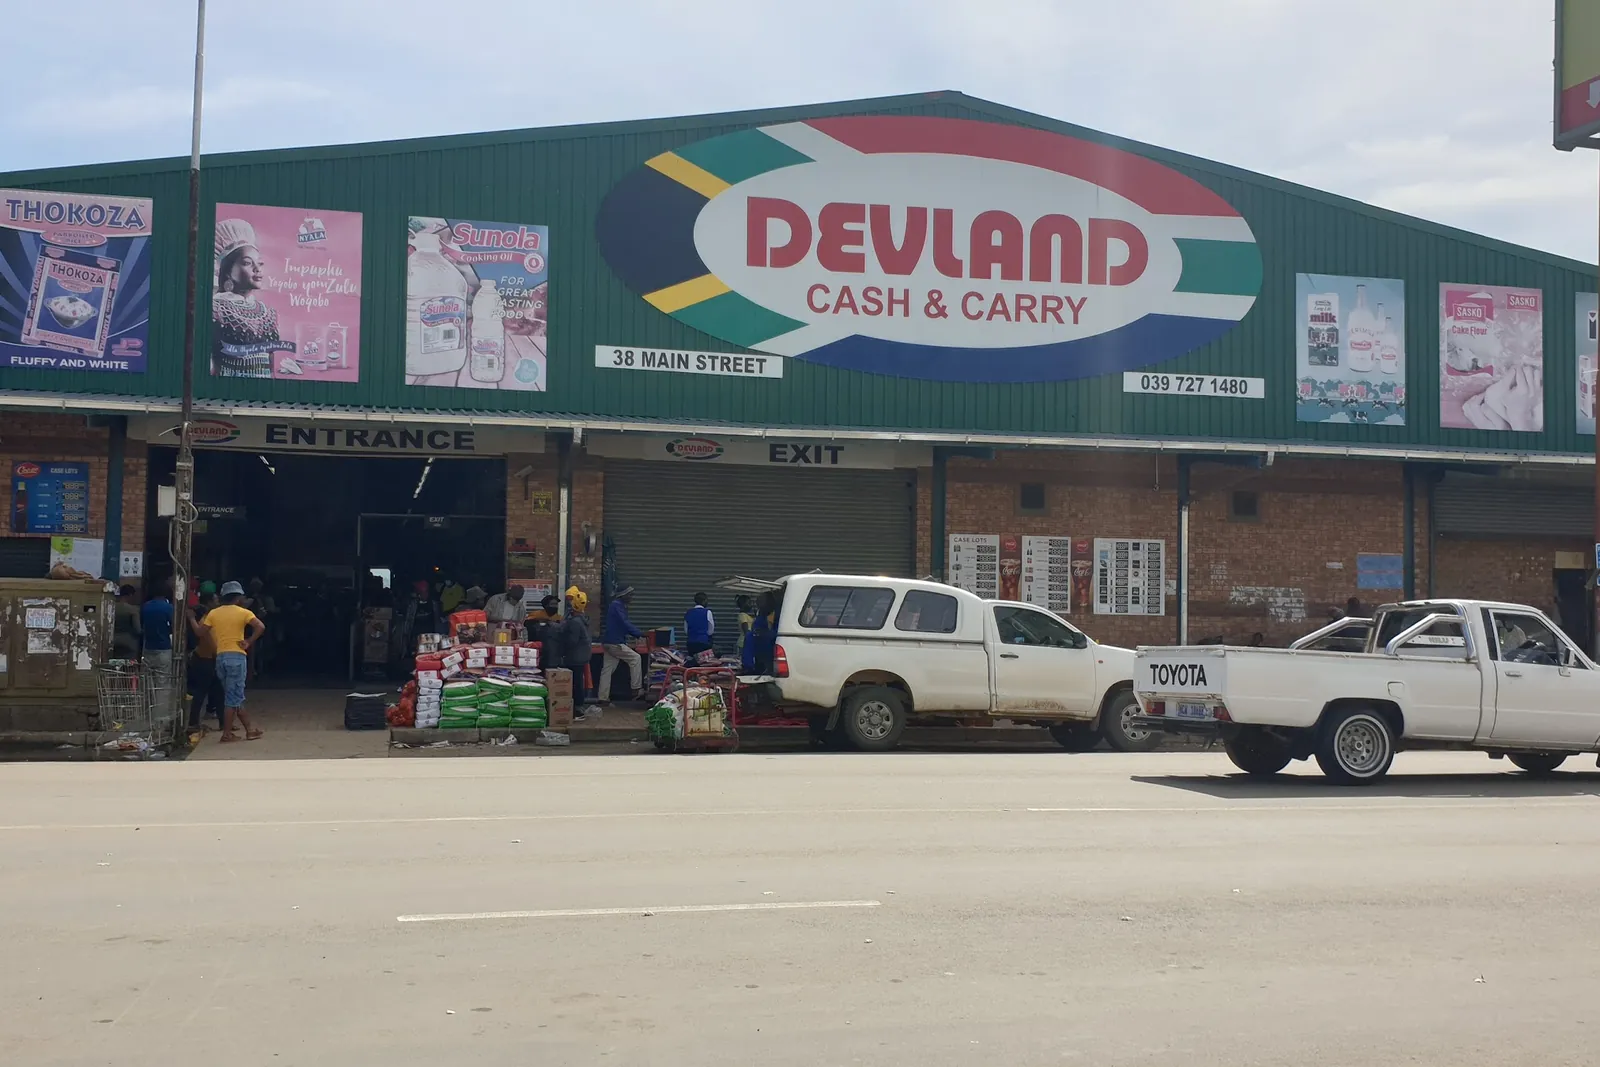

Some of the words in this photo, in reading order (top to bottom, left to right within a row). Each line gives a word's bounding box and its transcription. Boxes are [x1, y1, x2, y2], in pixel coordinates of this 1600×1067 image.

[6, 199, 146, 230] THOKOZA
[299, 232, 325, 242] NYALA
[453, 223, 540, 250] Sunola
[747, 196, 1149, 286] DEVLAND
[460, 252, 498, 262] Cooking
[500, 252, 513, 261] Oil
[52, 263, 104, 284] THOKOZA
[500, 276, 525, 286] FOR
[498, 287, 536, 298] GREAT
[497, 299, 543, 309] TASTING
[806, 284, 910, 317] CASH
[924, 289, 949, 320] &
[961, 291, 1088, 325] CARRY
[1509, 295, 1536, 308] SASKO
[426, 303, 459, 314] Sunola
[492, 309, 524, 319] FOOD
[1456, 306, 1482, 318] SASKO
[1310, 312, 1337, 323] milk
[1452, 325, 1469, 334] Cake
[1470, 326, 1487, 335] Flour
[10, 356, 58, 366] FLUFFY
[59, 358, 87, 368] AND
[88, 360, 129, 370] WHITE
[612, 349, 635, 367] 38
[641, 351, 690, 370] MAIN
[695, 355, 767, 374] STREET
[1140, 374, 1170, 391] 039
[1175, 376, 1205, 393] 727
[1210, 378, 1248, 395] 1480
[266, 423, 475, 450] ENTRANCE
[677, 445, 713, 453] DEVLAND
[769, 443, 845, 465] EXIT
[198, 506, 236, 514] ENTRANCE
[1150, 664, 1208, 686] TOYOTA
